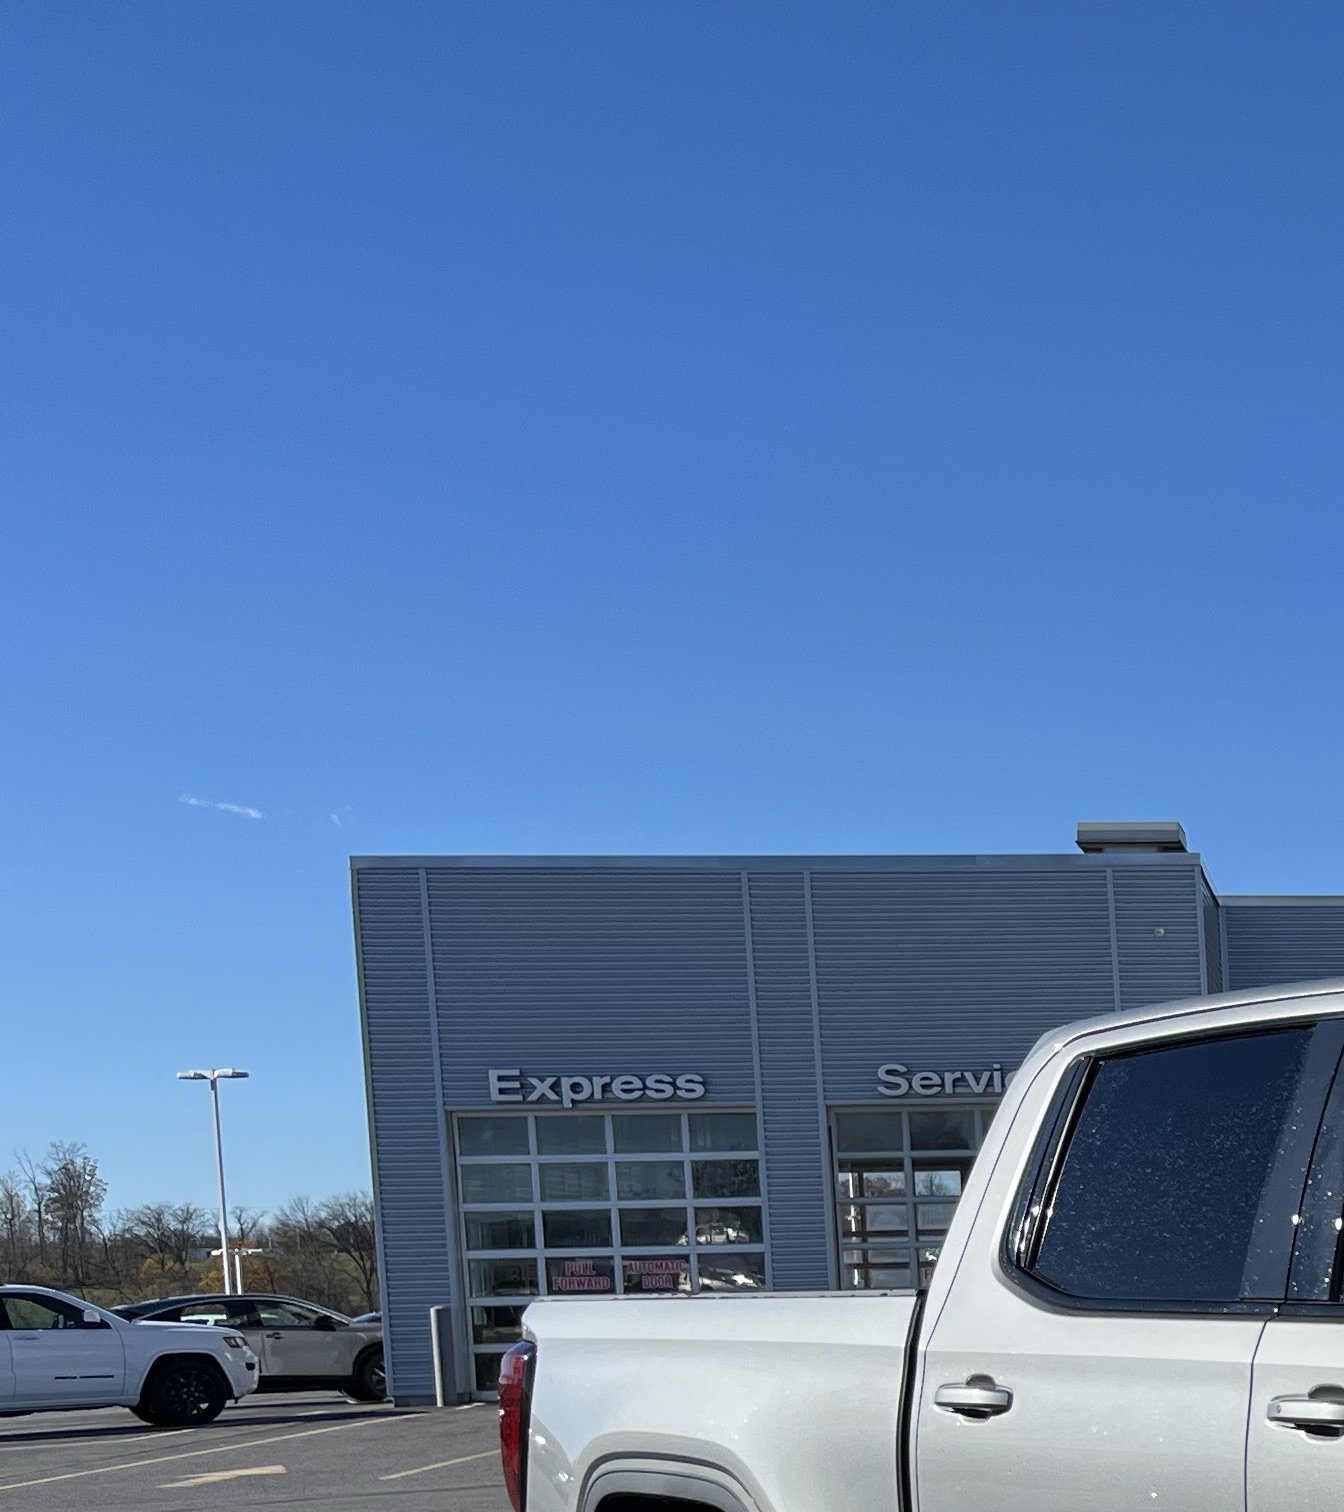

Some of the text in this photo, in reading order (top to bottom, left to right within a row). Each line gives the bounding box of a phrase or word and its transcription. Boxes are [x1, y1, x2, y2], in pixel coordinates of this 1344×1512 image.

[487, 1069, 707, 1108] Express
[564, 1260, 597, 1275] PULL
[626, 1259, 689, 1274] AUTOMATIC
[552, 1276, 611, 1291] FORWARD
[641, 1275, 674, 1290] DOOR
